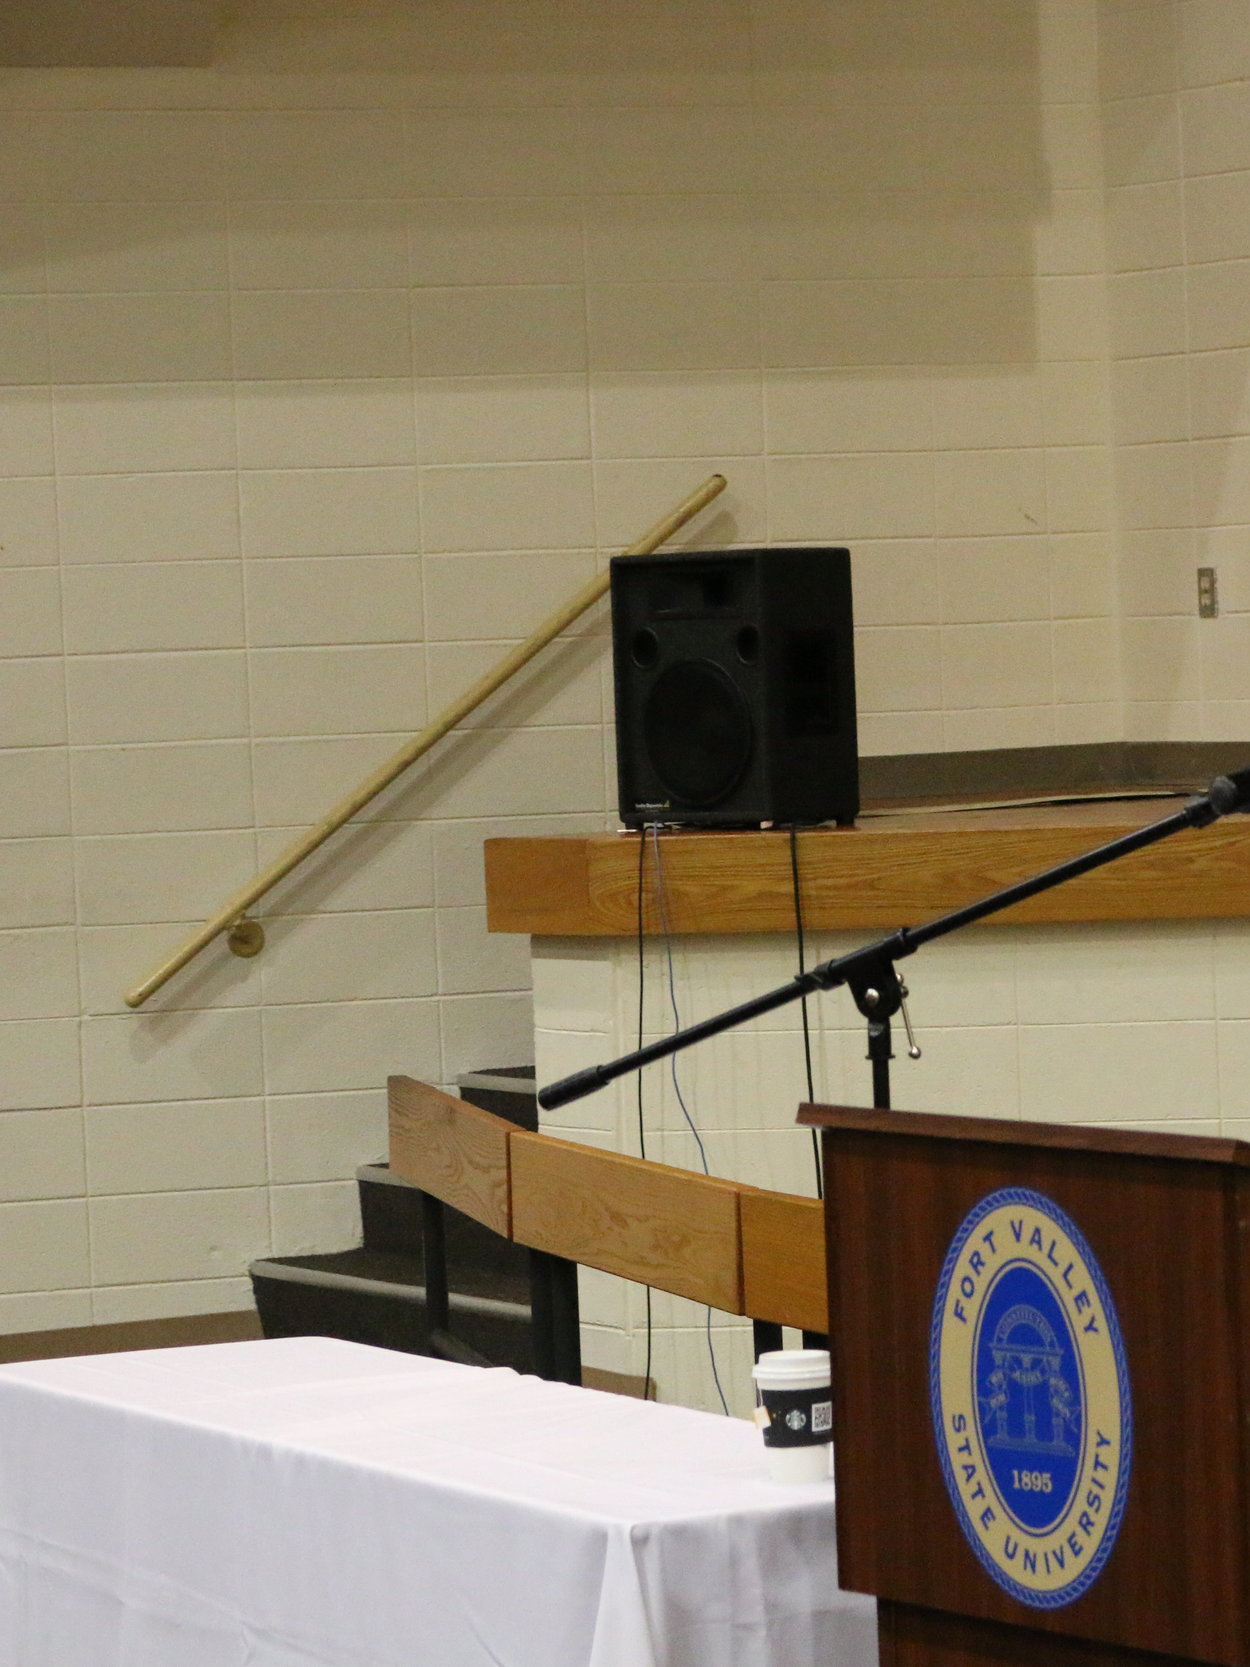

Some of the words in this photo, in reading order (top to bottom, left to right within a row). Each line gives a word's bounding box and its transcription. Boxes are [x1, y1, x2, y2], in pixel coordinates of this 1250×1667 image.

[954, 1230, 997, 1324] FORT
[1009, 1219, 1099, 1336] VALLEY
[951, 1412, 995, 1532] STATE
[1003, 1430, 1112, 1576] UNIVERSITY
[1011, 1469, 1053, 1493] 1895
